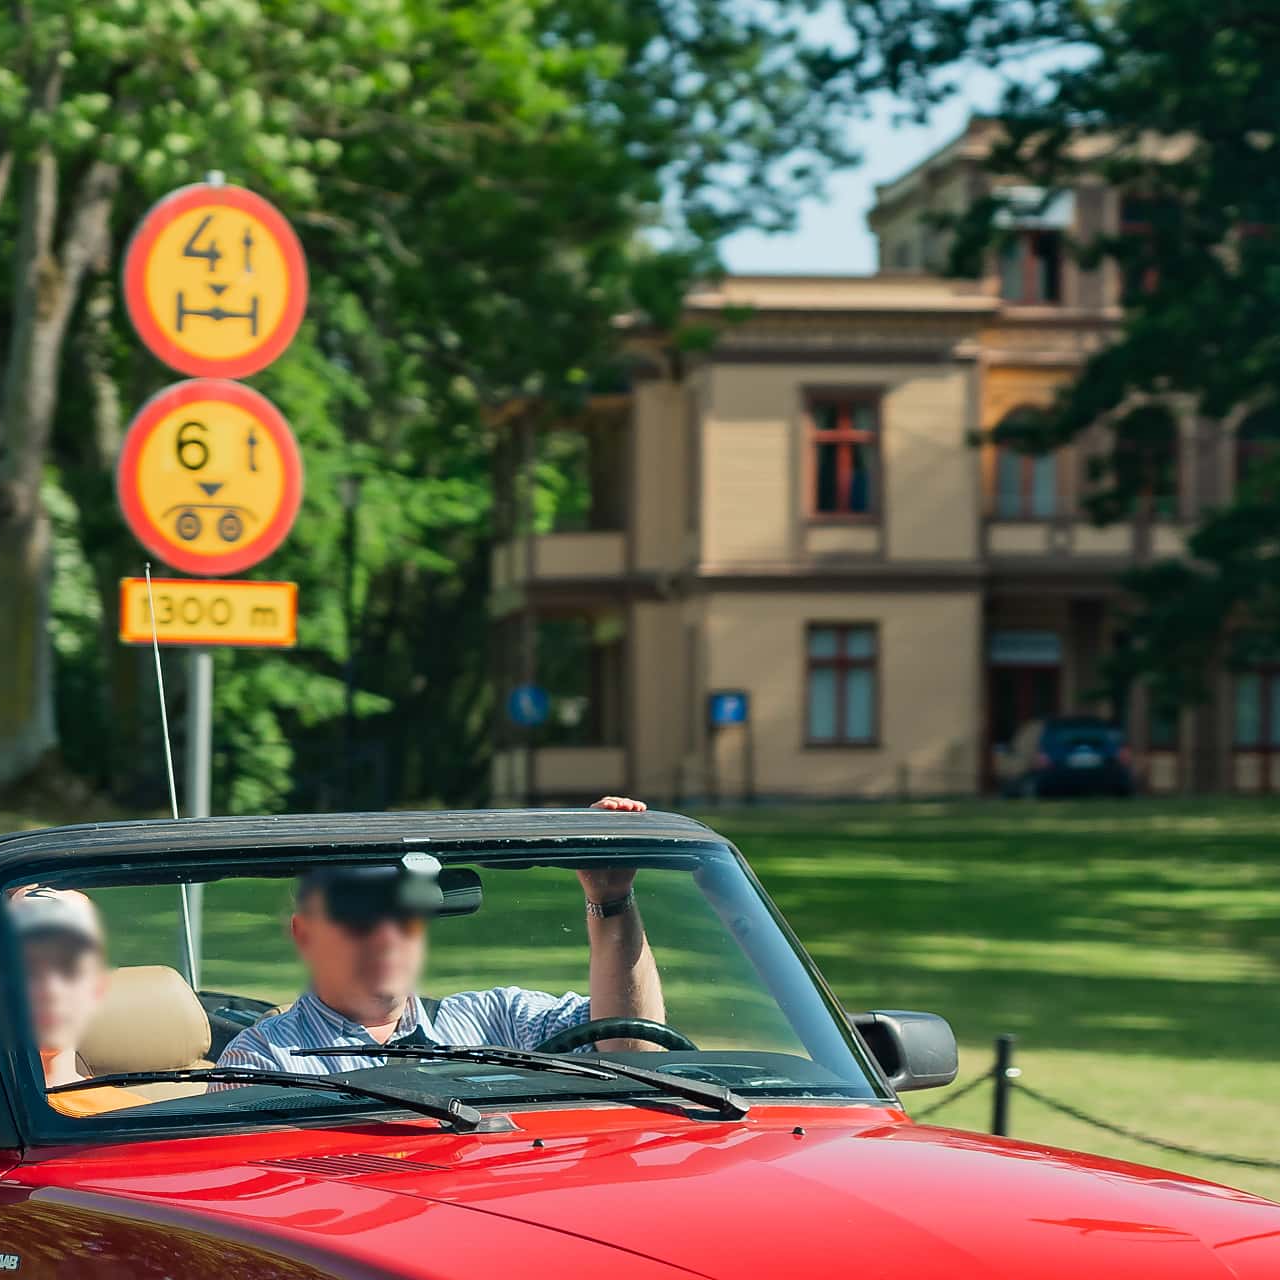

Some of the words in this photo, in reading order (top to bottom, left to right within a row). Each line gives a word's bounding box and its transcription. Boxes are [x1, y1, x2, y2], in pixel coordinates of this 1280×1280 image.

[182, 213, 222, 273] 4
[241, 227, 256, 273] t
[176, 421, 209, 471] 6
[245, 428, 259, 472] t
[250, 605, 280, 627] m
